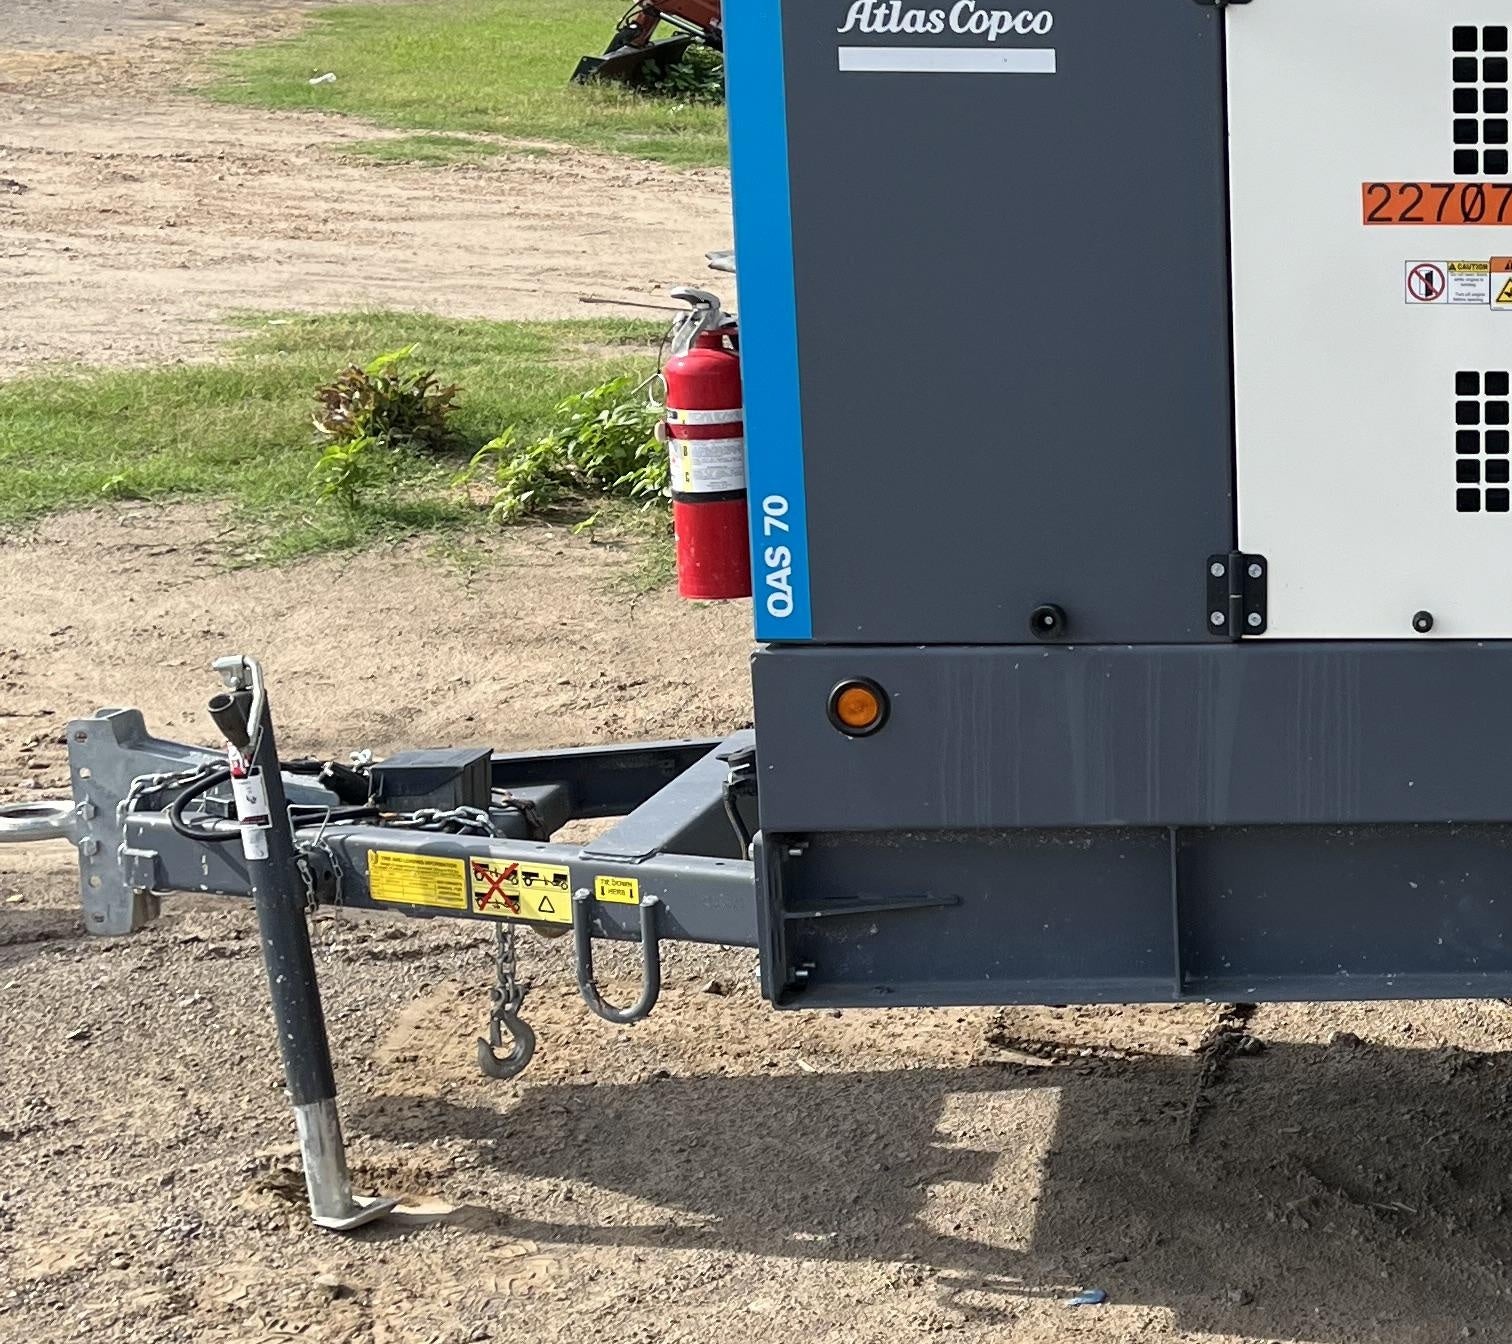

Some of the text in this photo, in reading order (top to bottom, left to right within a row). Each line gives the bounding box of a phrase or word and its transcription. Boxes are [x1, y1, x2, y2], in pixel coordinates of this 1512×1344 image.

[1457, 263, 1488, 271] CAUTION
[762, 494, 794, 618] QAS 70
